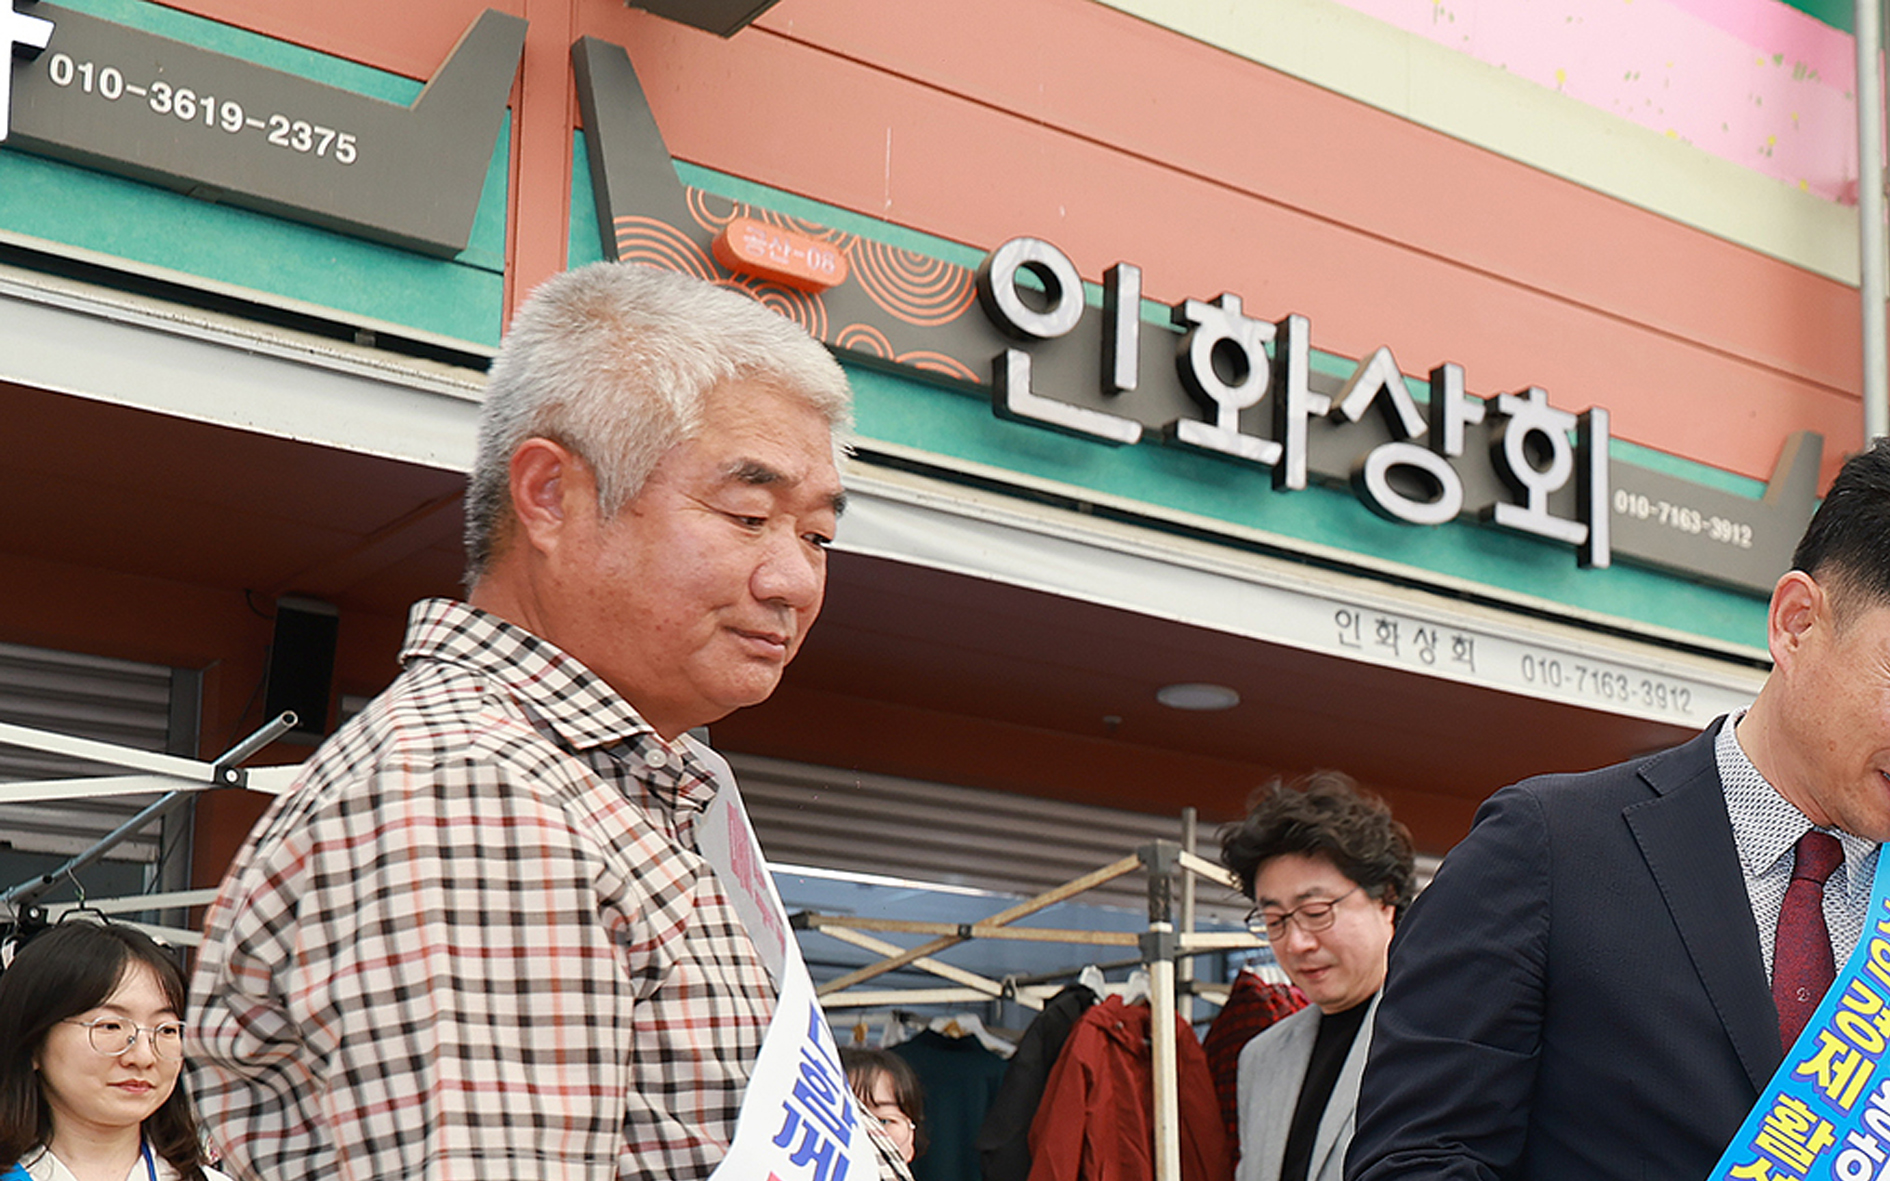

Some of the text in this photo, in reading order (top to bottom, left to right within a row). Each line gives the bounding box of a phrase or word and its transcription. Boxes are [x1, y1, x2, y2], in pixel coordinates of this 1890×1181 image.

[49, 53, 357, 164] 010-3619-2375
[980, 236, 1611, 570] 인화상회
[1614, 489, 1754, 548] 010-7163-3912
[1521, 654, 1693, 714] 010-7163-3912
